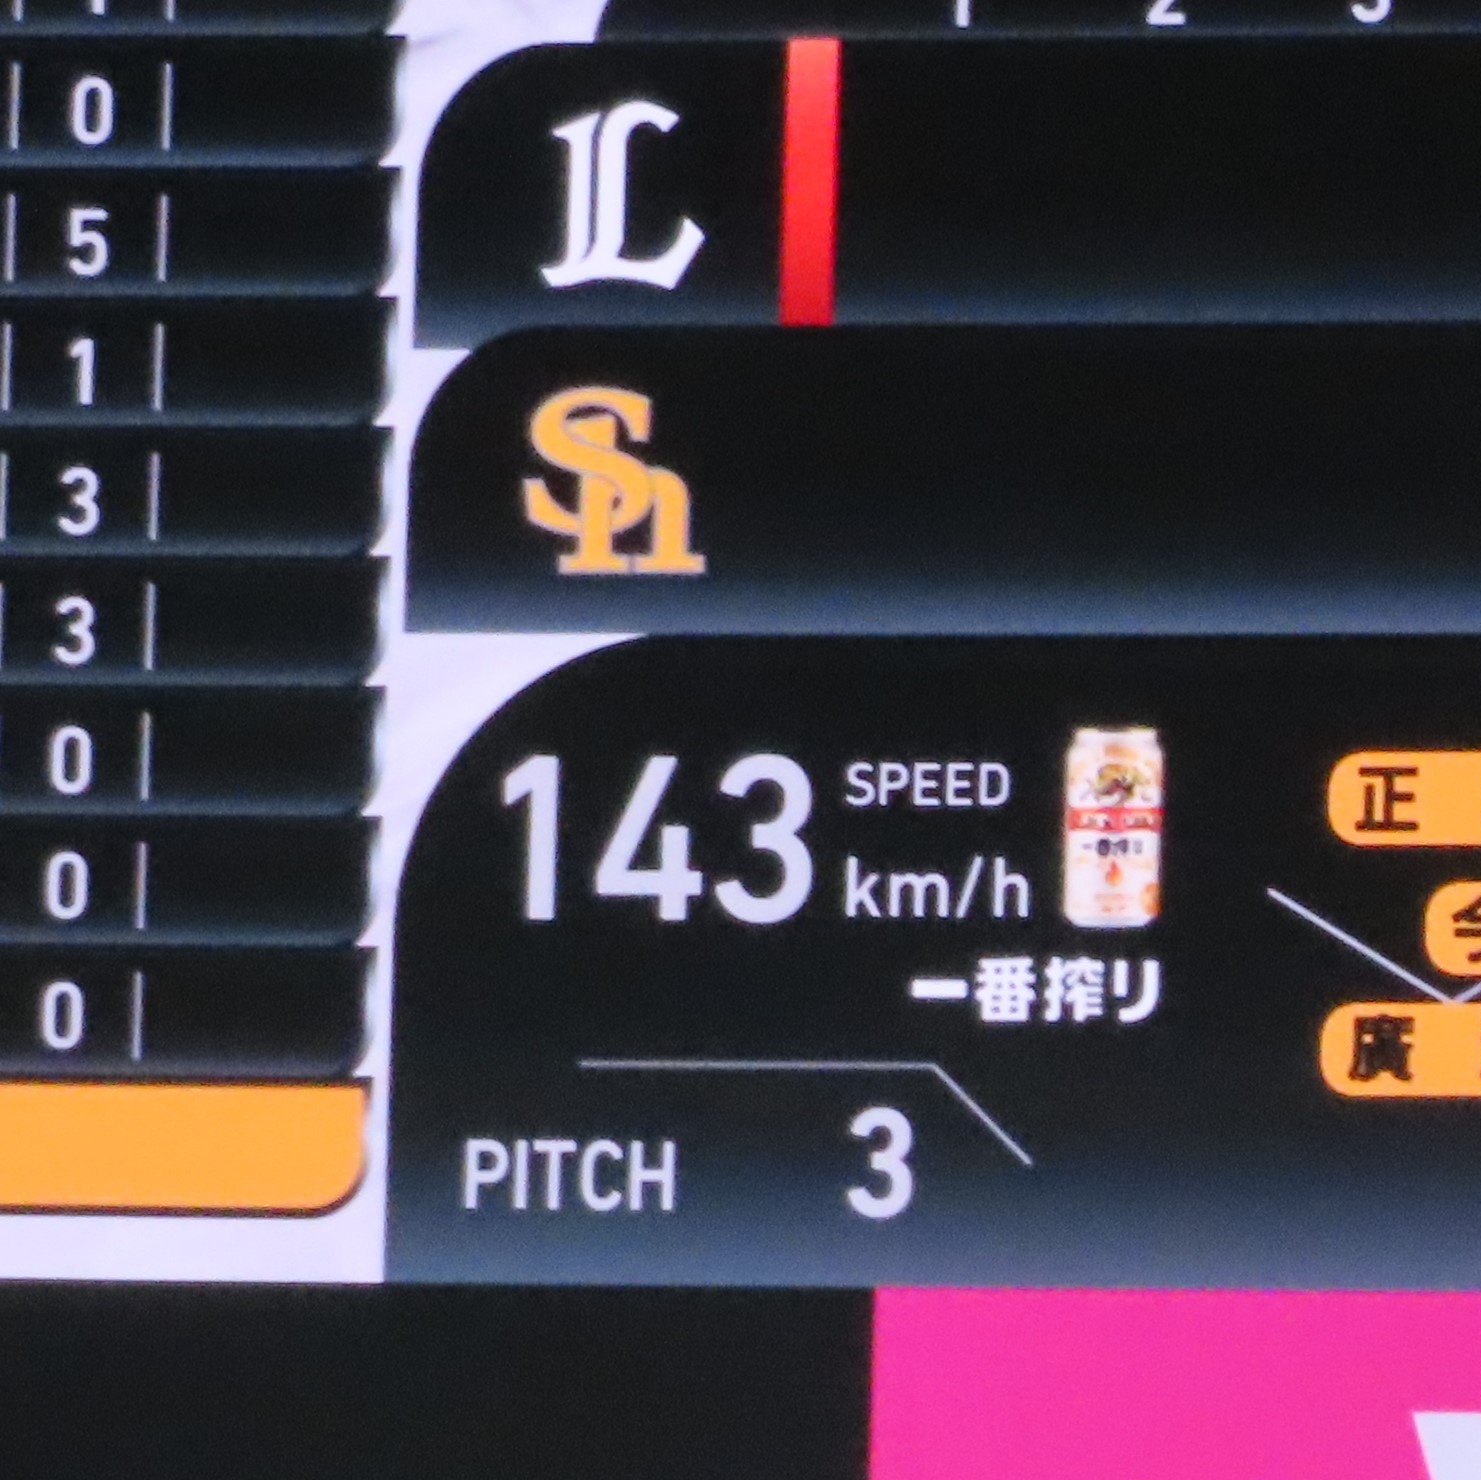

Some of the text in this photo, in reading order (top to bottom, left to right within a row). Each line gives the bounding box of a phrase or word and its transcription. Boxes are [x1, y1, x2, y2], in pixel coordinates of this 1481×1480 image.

[70, 75, 114, 145] 0
[540, 99, 705, 290] L
[68, 207, 108, 277] 5
[69, 338, 94, 405] 1
[58, 466, 100, 536] 3
[54, 596, 95, 666] 3
[49, 725, 92, 795] 0
[845, 761, 1010, 807] SPEED
[503, 753, 813, 924] 143
[44, 851, 88, 920] 0
[844, 856, 1029, 919] km/h
[40, 981, 84, 1050] 0
[910, 956, 1160, 1023] 一番搾り
[463, 1106, 913, 1220] PITCH 3
